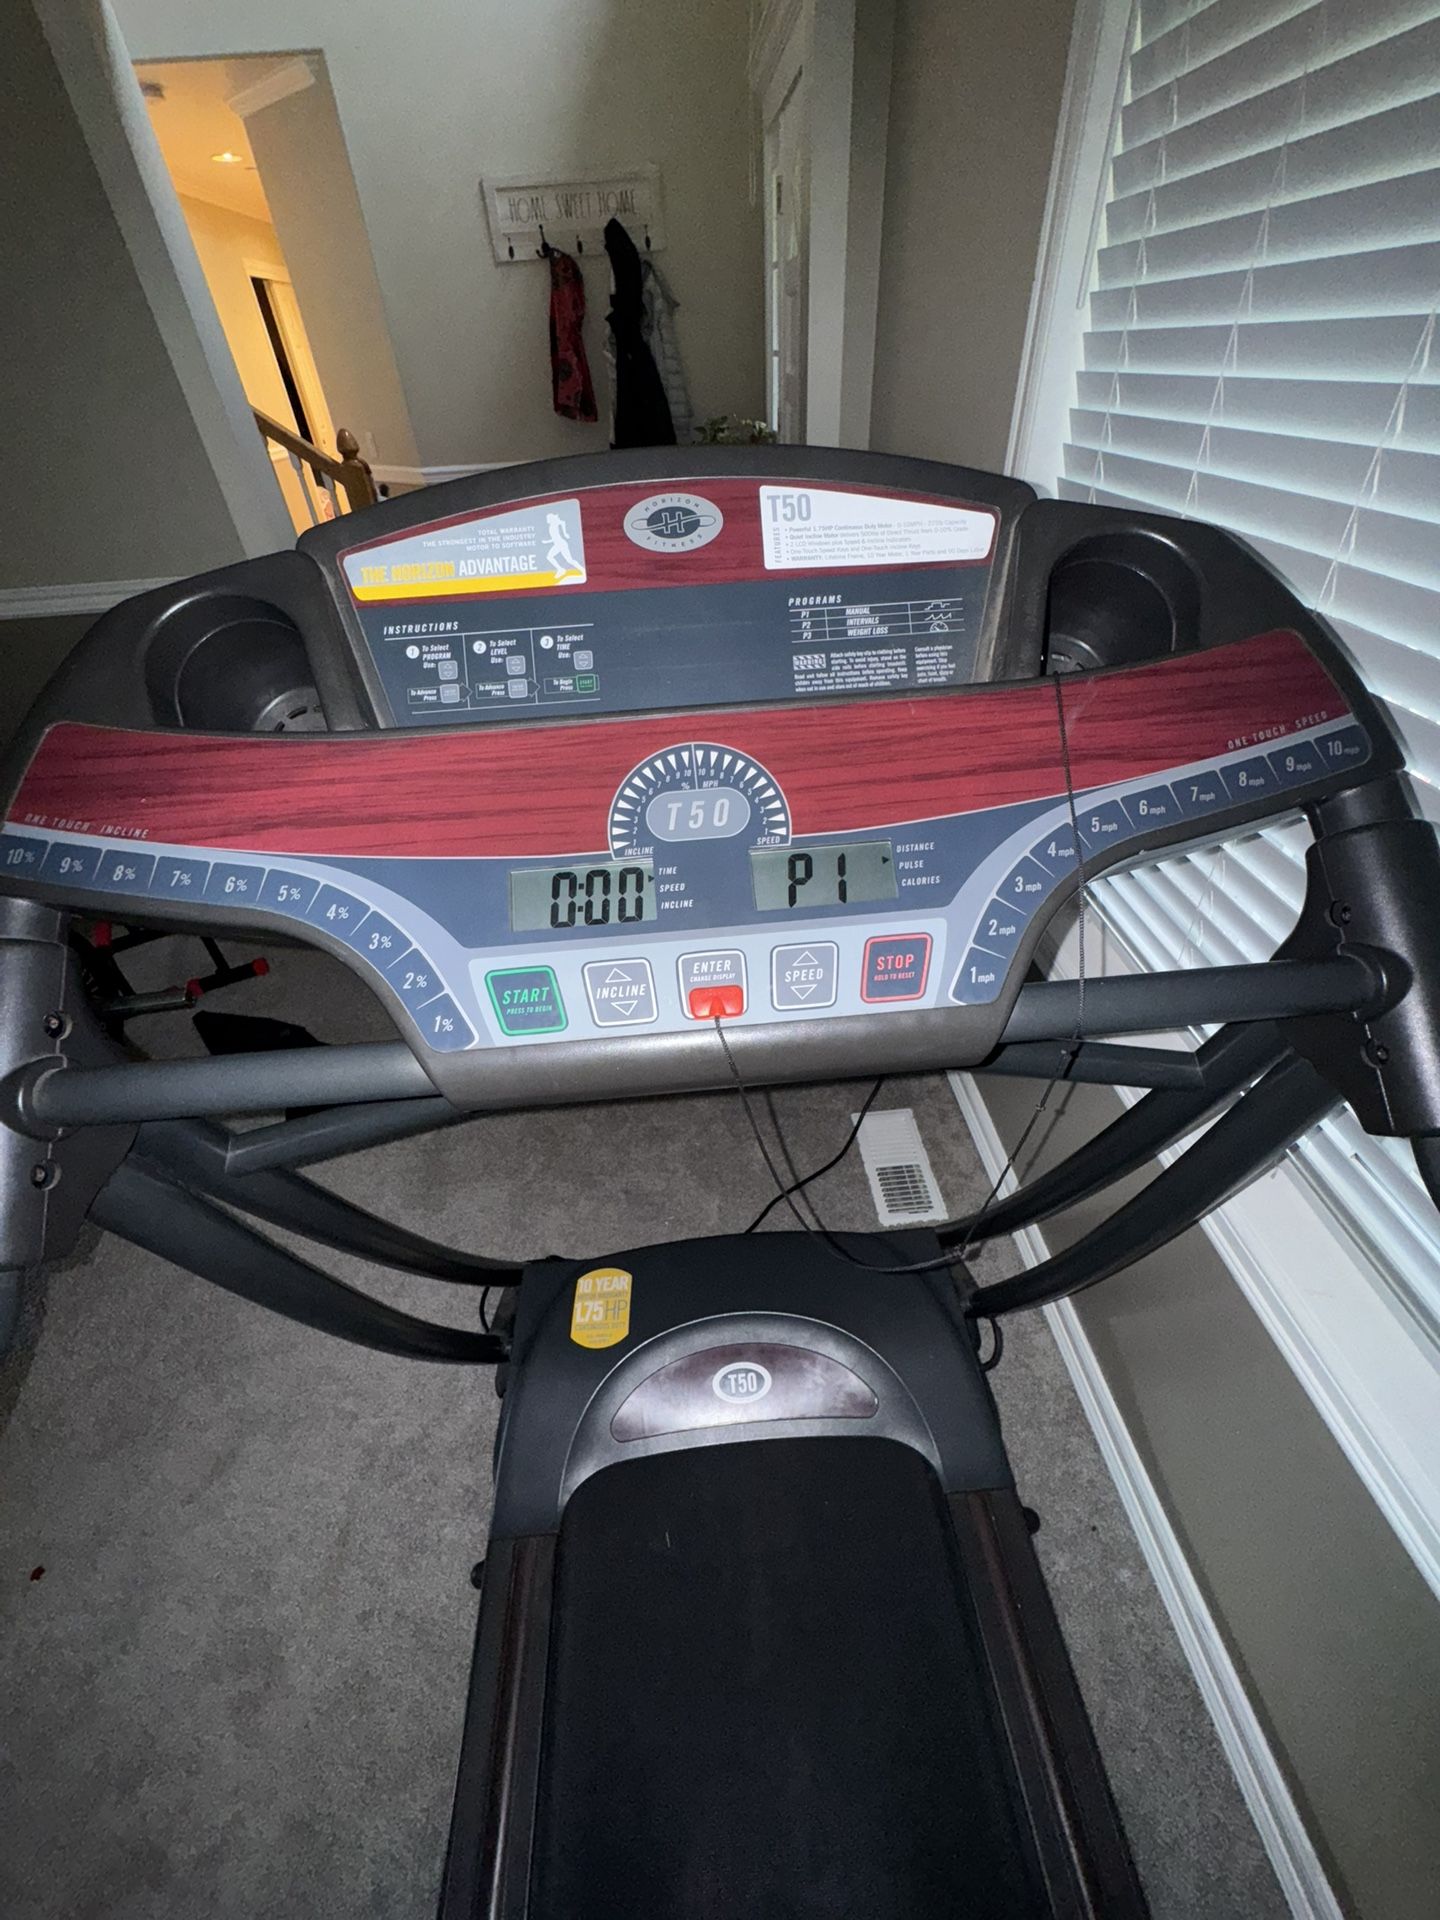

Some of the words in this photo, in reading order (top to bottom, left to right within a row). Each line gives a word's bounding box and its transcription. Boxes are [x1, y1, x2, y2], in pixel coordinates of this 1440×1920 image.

[508, 196, 549, 223] HOME
[556, 193, 592, 219] SWEET
[598, 189, 638, 216] HOME
[644, 497, 700, 512] HORIZON
[767, 494, 811, 522] T50
[478, 528, 498, 536] TOTAL
[500, 526, 535, 534] WARRANTY
[438, 538, 476, 546] STRONGEST
[503, 533, 536, 541] INDUSTRY
[459, 554, 537, 576] ADVANTAGE
[788, 595, 842, 606] PROGRAMS
[801, 610, 809, 618] P1
[845, 607, 870, 615] MANUAL
[384, 621, 459, 635] INSTRUCTIONS
[802, 621, 811, 629] P2
[846, 617, 879, 626] INTERVALS
[802, 631, 812, 640] P3
[847, 628, 871, 636] WEIGHT
[873, 626, 888, 635] LOSS
[498, 639, 516, 647] Select
[422, 652, 451, 660] PROGRAM
[490, 648, 507, 656] LEVEL
[1227, 736, 1249, 750] ONE
[1252, 725, 1286, 742] TOUCH
[1295, 711, 1328, 728] SPEED
[1328, 740, 1342, 756] 10
[1286, 756, 1295, 772] 9
[1296, 762, 1312, 772] mph
[702, 780, 719, 788] MPH
[1239, 771, 1247, 787] 8
[1249, 776, 1265, 787] mph
[1191, 786, 1198, 802] 7
[1199, 791, 1216, 802] mph
[667, 798, 730, 831] T50
[1139, 799, 1147, 816] 6
[1149, 805, 1166, 816] mph
[24, 813, 46, 825] ONE
[52, 818, 90, 831] TOUCH
[100, 825, 150, 839] INCLINE
[1091, 816, 1100, 832] 5
[1101, 821, 1118, 832] mph
[756, 836, 780, 845] SPEED
[896, 842, 935, 853] DISTANCE
[6, 848, 35, 864] 10%
[624, 846, 654, 856] INCLINE
[1047, 841, 1057, 857] 4
[1058, 847, 1075, 857] mph
[59, 857, 84, 873] 9%
[113, 864, 136, 881] 8%
[658, 866, 677, 875] TIME
[899, 860, 924, 869] PULSE
[170, 870, 192, 887] 7%
[225, 876, 248, 893] 6%
[788, 853, 847, 908] P1
[901, 876, 941, 887] CALORIES
[1014, 876, 1023, 893] 3
[1025, 882, 1041, 892] mph
[278, 885, 301, 901] 5%
[659, 883, 685, 892] SPEED
[550, 867, 644, 928] 0:00
[660, 899, 694, 910] INCLINE
[326, 904, 349, 920] 4%
[988, 919, 997, 936] 2
[999, 925, 1016, 936] mph
[369, 933, 392, 949] 3%
[693, 959, 732, 974] ENTER
[876, 954, 914, 970] STOP
[403, 972, 428, 990] 2%
[690, 974, 712, 983] CHANGE
[712, 972, 736, 982] DISPLAY
[784, 968, 823, 982] SPEED
[873, 973, 889, 982] HOLD
[889, 973, 898, 981] TO
[898, 971, 915, 980] RESET
[970, 966, 976, 983] 1
[978, 973, 995, 983] mph
[502, 987, 550, 1005] START
[596, 984, 646, 999] INCLINE
[506, 1007, 525, 1015] PRESS
[526, 1006, 534, 1015] TO
[534, 1005, 552, 1013] BEGIN
[434, 1015, 453, 1033] 1%
[579, 1279, 592, 1293] 10
[596, 1276, 628, 1291] YEAR
[728, 1372, 757, 1394] T50
